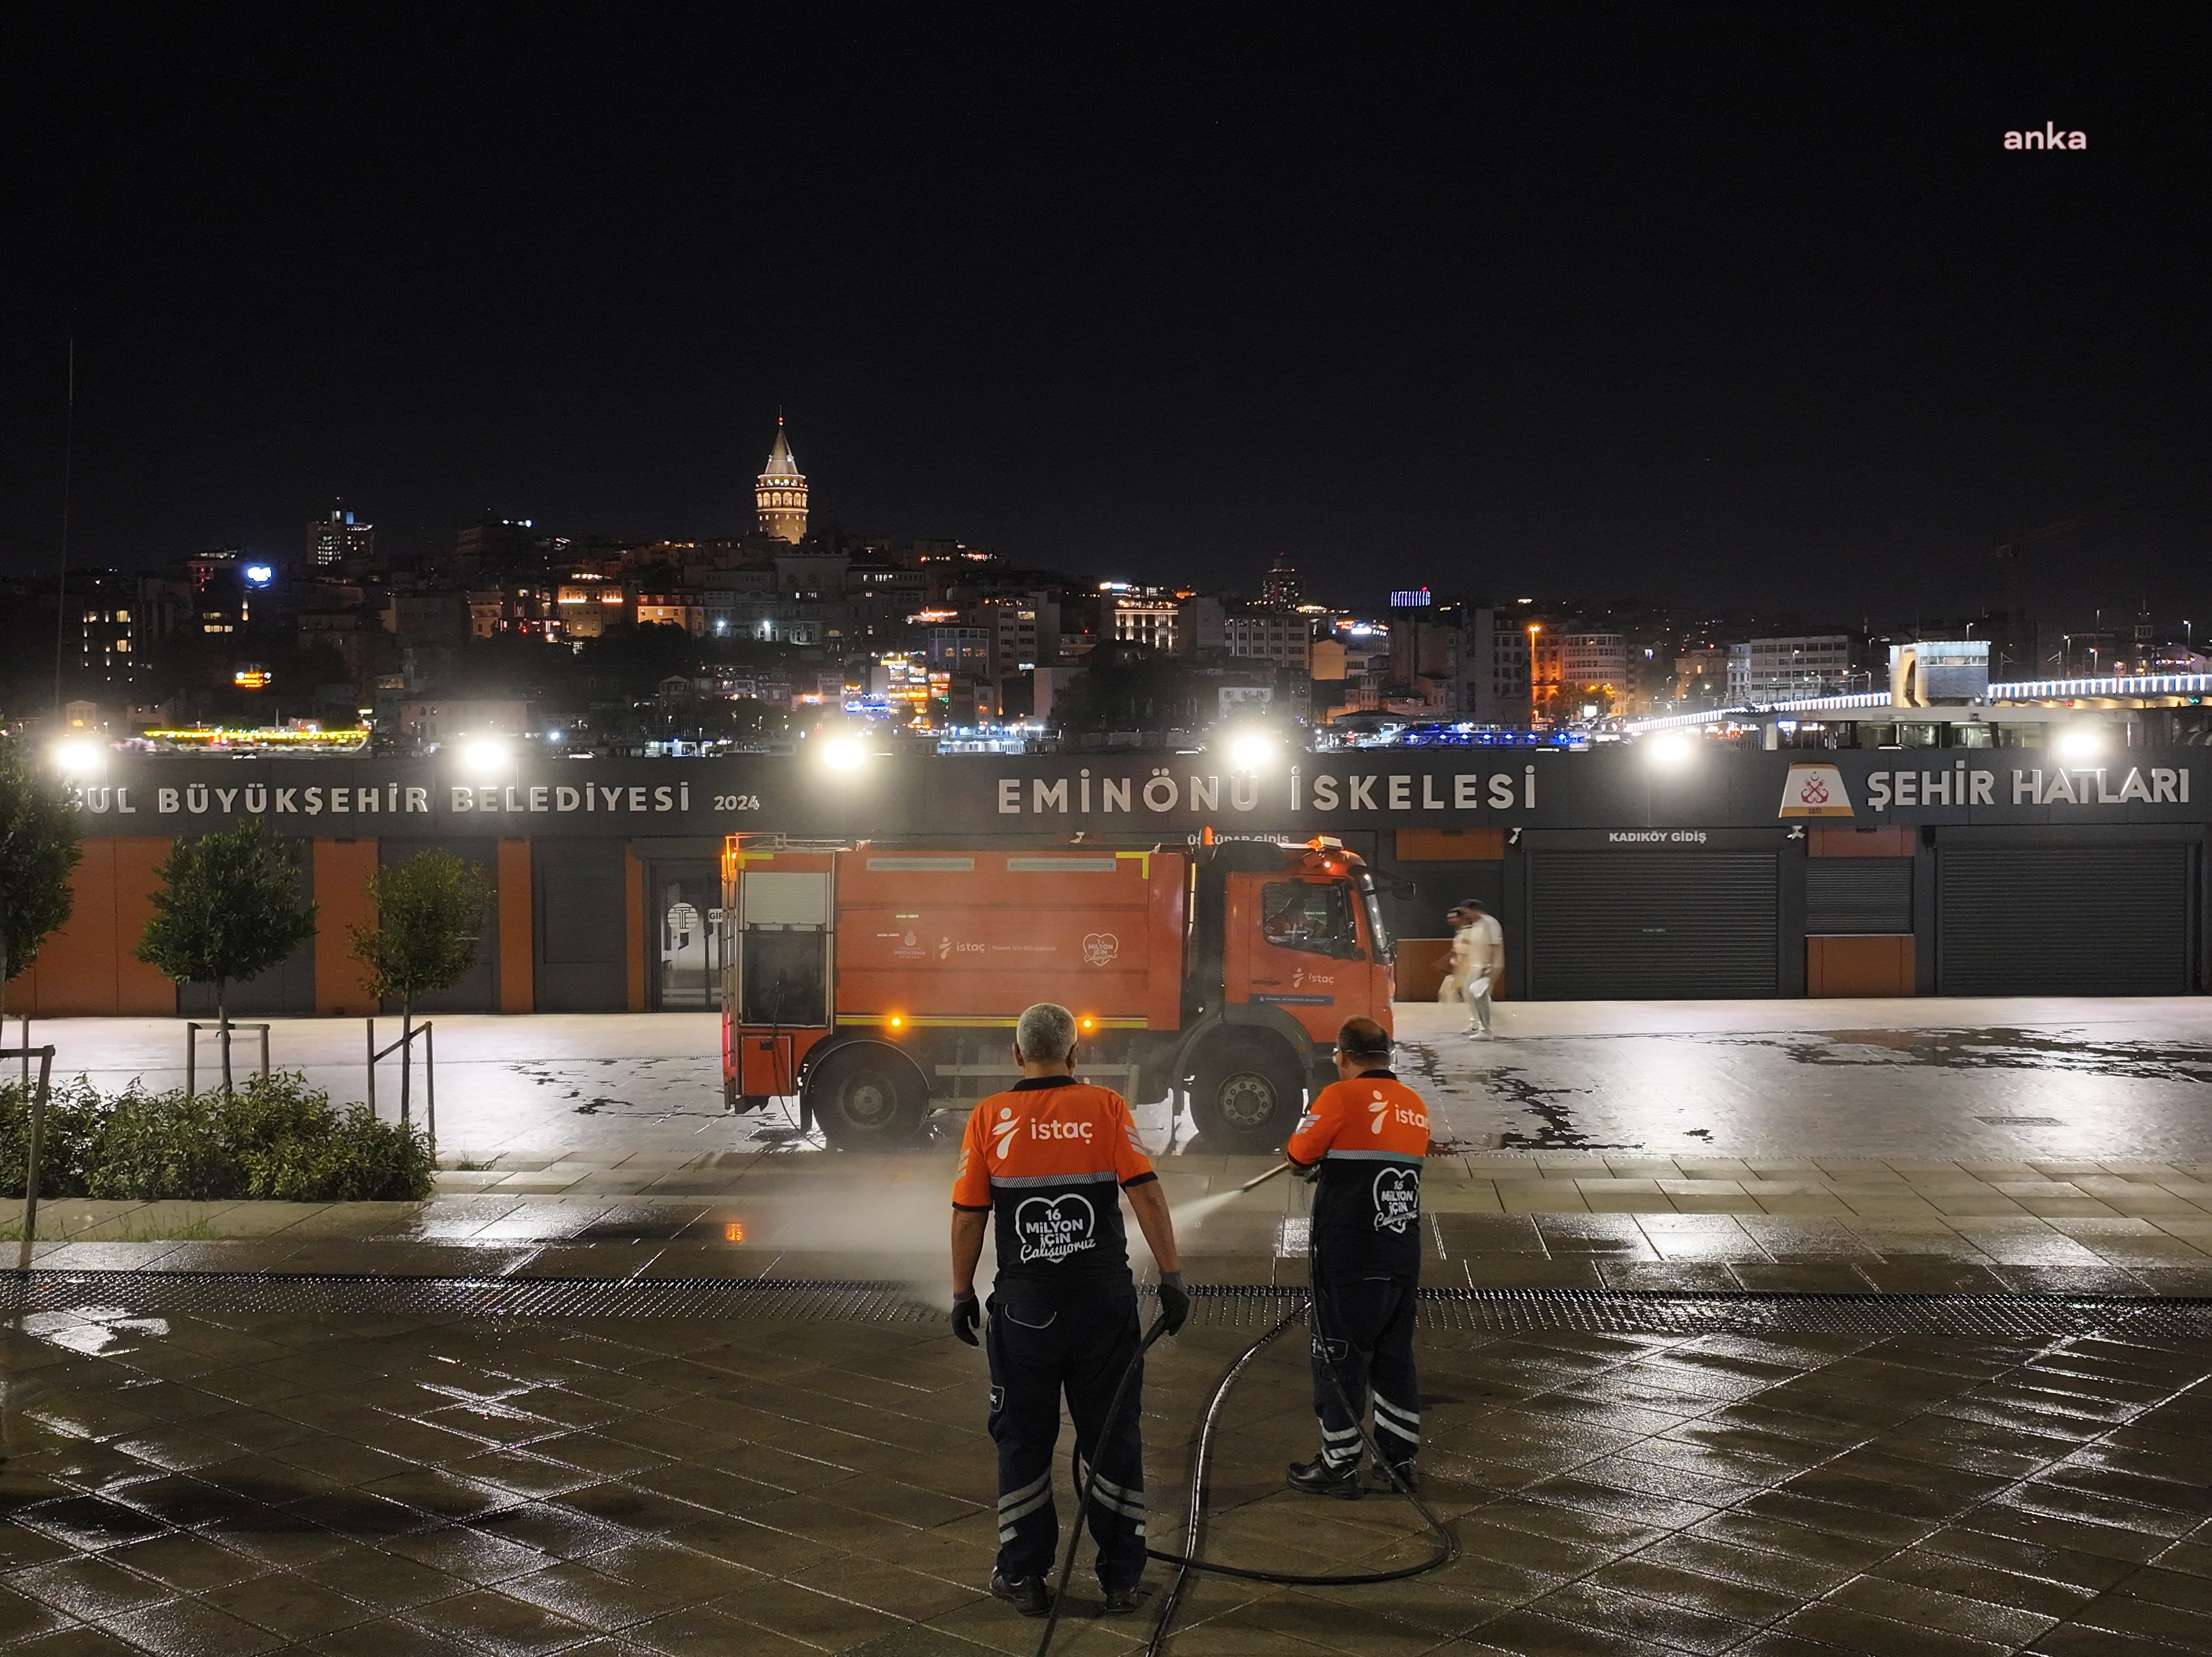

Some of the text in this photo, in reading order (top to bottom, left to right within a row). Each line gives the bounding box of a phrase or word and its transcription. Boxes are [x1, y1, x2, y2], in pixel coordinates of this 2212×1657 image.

[999, 765, 1535, 813] EMİNÖNÜ İSKELESİ
[1867, 760, 2189, 812] ŞEHİR HATLARI
[159, 783, 428, 815] BÜYÜKŞEHİR
[451, 782, 689, 813] BELEDİYESİ
[714, 795, 759, 810] 2024
[1610, 831, 1707, 844] KADIKÖY GİDİŞ
[957, 942, 985, 954] istaç
[1309, 973, 1335, 985] istaç
[1031, 1118, 1093, 1144] istaç
[1394, 1180, 1404, 1190] 16
[1045, 1208, 1062, 1221] 16
[1020, 1238, 1096, 1264] Çalışıyoruz
